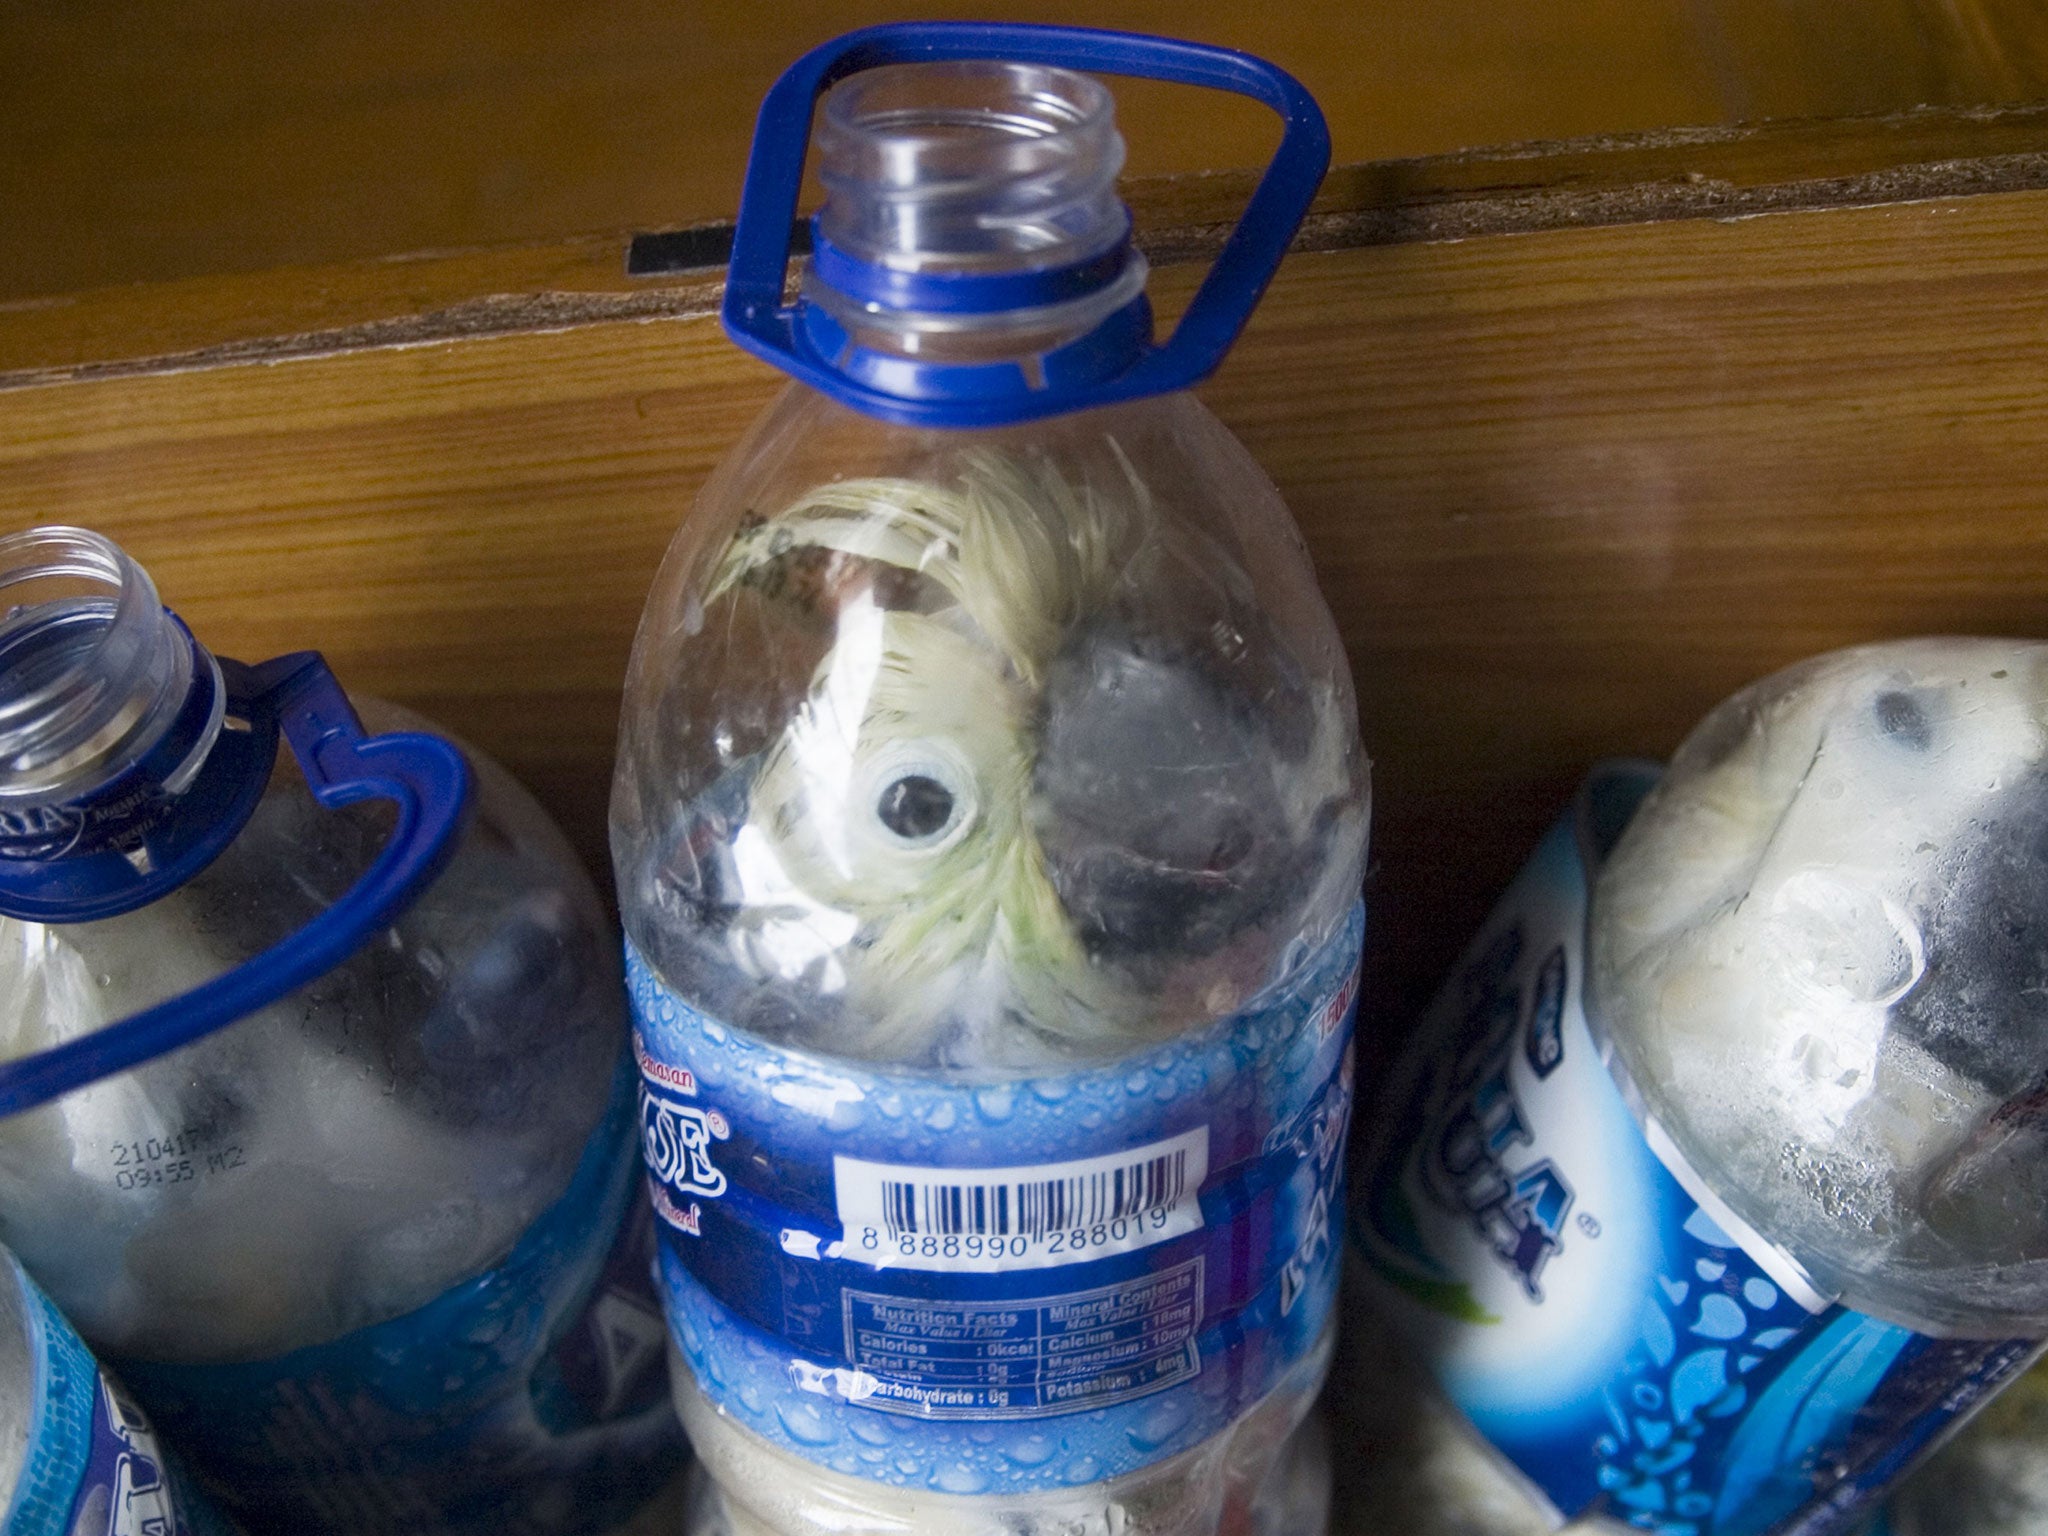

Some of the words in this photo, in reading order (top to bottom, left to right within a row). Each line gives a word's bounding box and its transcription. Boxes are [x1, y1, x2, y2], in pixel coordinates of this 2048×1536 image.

[861, 1226, 879, 1250] 8
[899, 1231, 1029, 1259] 888990
[1047, 1205, 1169, 1255] 288019
[1049, 1294, 1116, 1321] Mineral
[1119, 1274, 1191, 1305] Contents
[872, 1304, 958, 1326] Nutrition
[963, 1311, 1019, 1327] Facts
[1064, 1316, 1096, 1331] Max
[884, 1321, 917, 1336] Max
[919, 1324, 960, 1338] Value
[1048, 1330, 1115, 1352] Calcium
[859, 1333, 928, 1355] Calories
[1048, 1342, 1140, 1369] Magnesium
[859, 1352, 903, 1370] Total
[907, 1357, 936, 1373] Fat
[876, 1381, 975, 1405] arbohydrate
[988, 1388, 1010, 1407] 0g
[1046, 1373, 1132, 1400] Potassium
